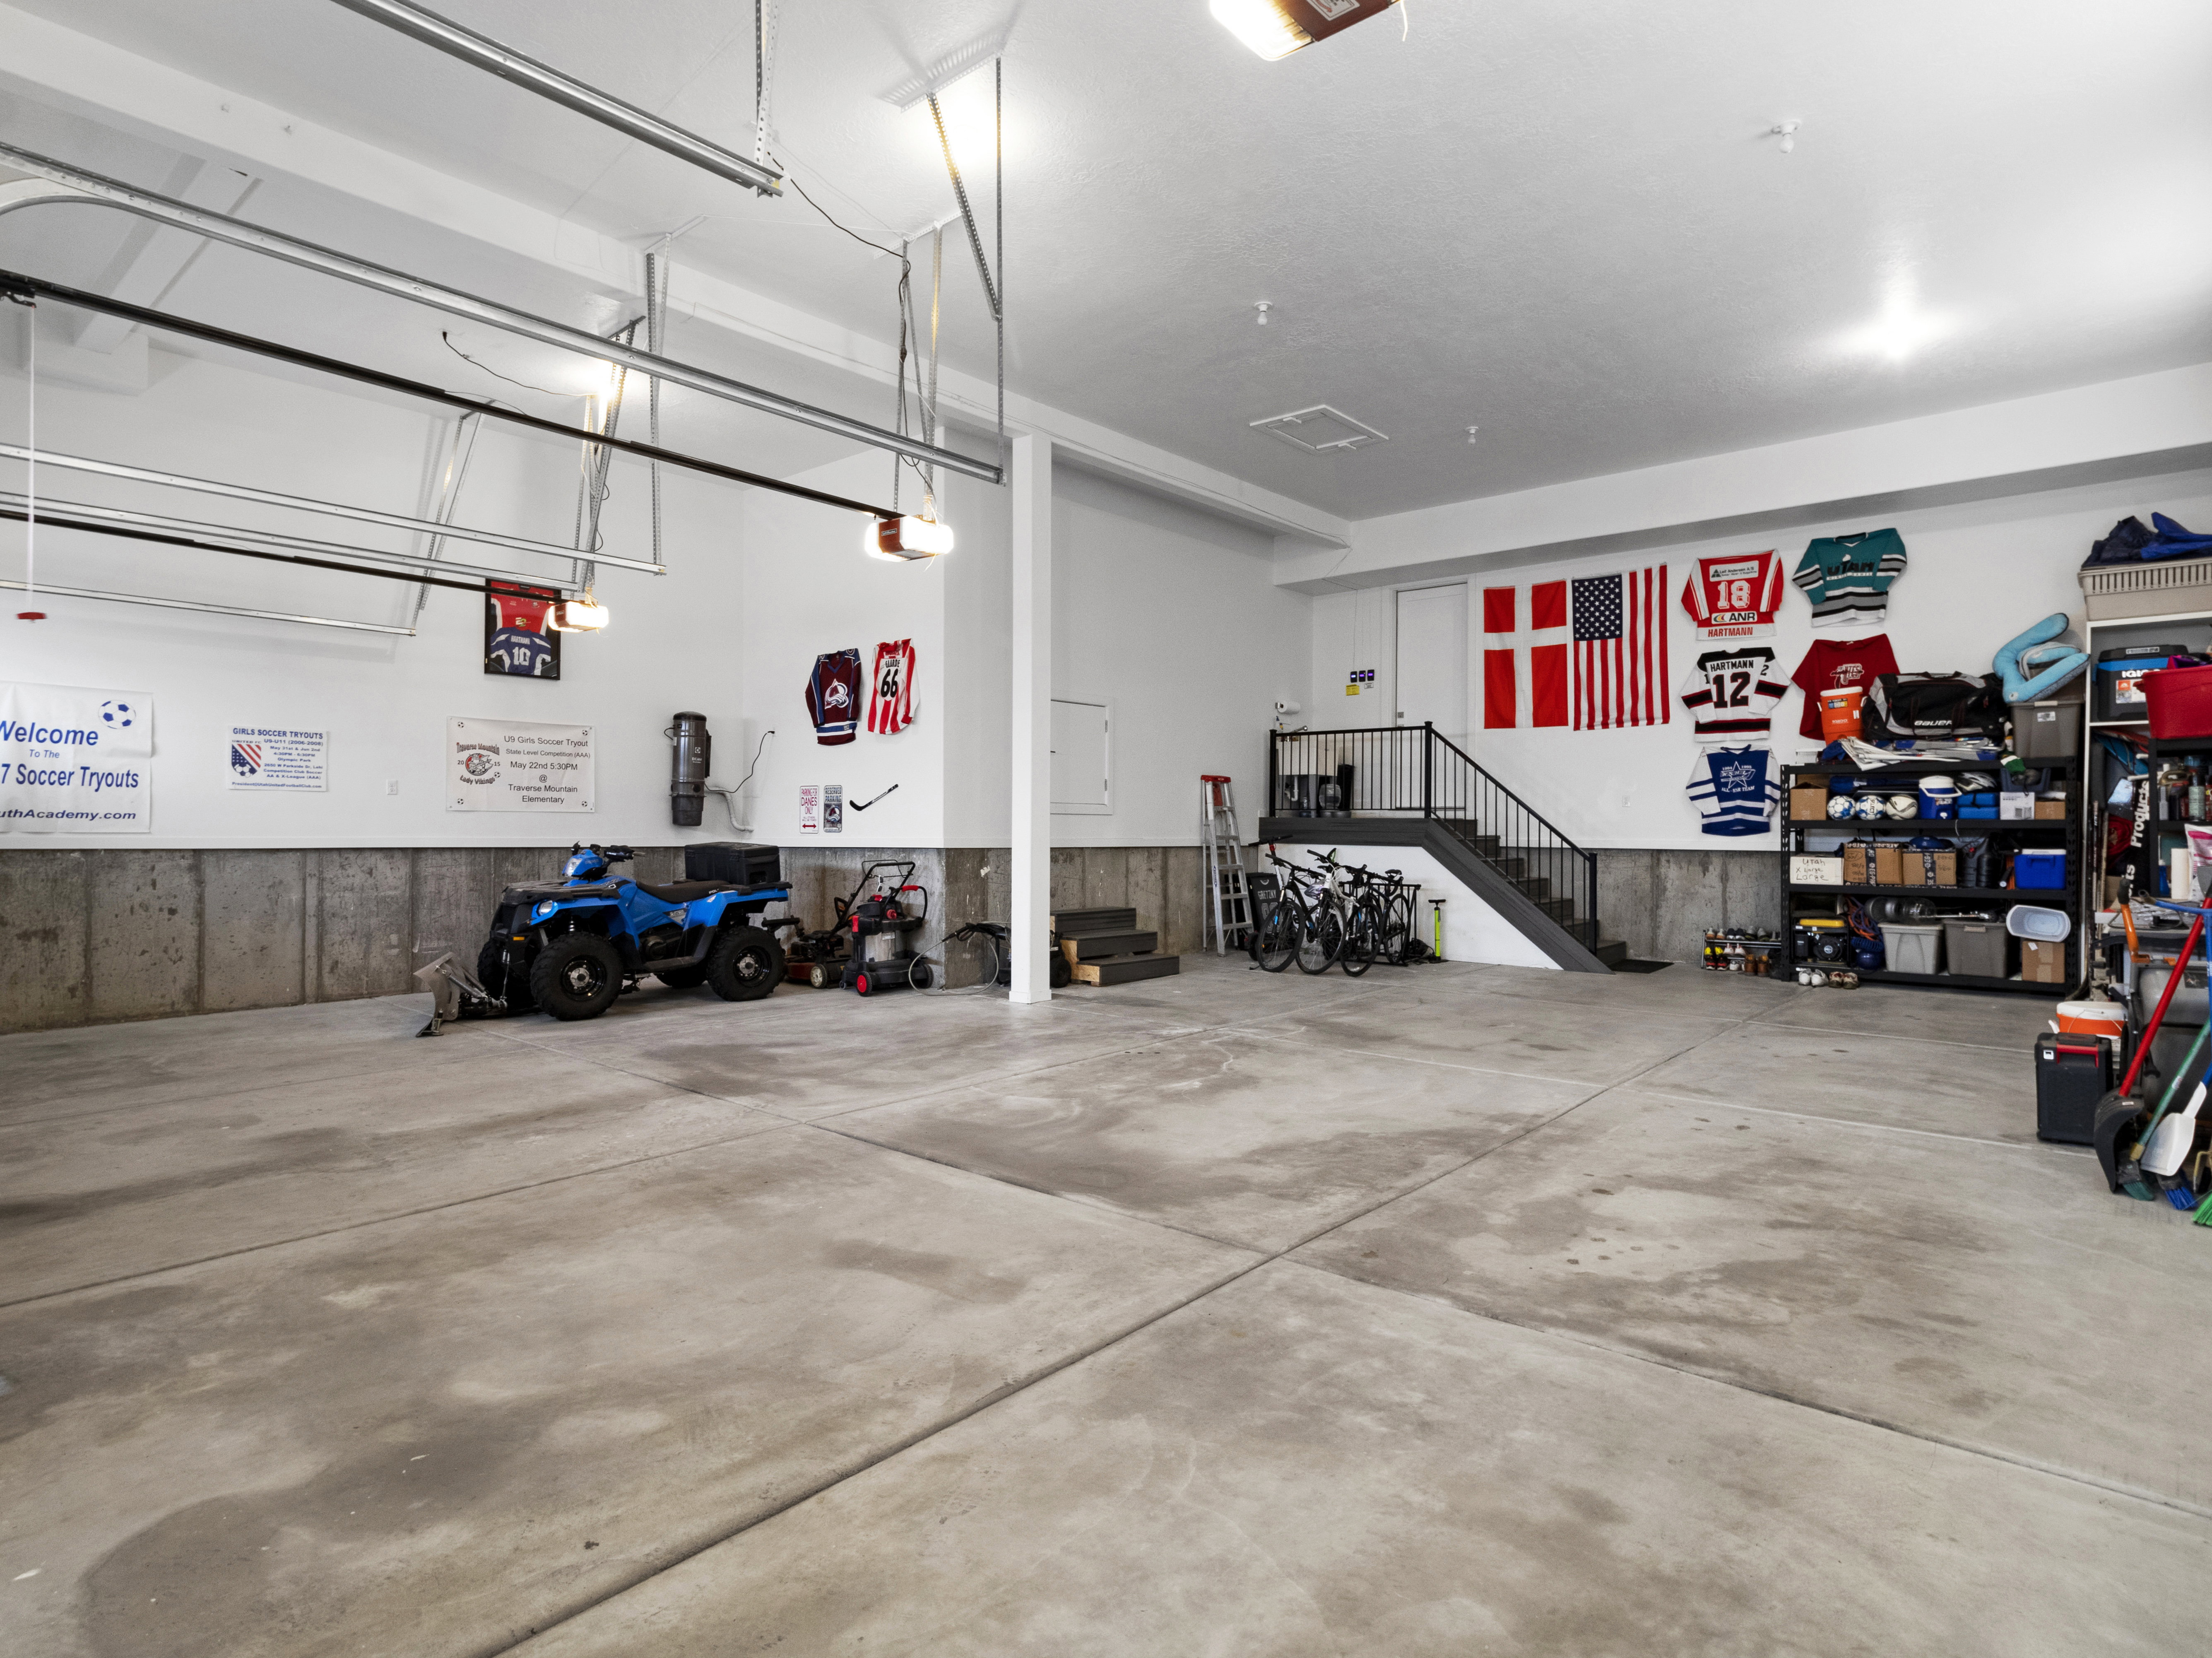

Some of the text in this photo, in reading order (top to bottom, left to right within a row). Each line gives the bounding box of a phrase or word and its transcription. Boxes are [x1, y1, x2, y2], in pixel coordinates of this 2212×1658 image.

[1827, 560, 1875, 576] UTAH
[1718, 580, 1750, 609] 18
[1729, 612, 1755, 622] ANR
[1708, 627, 1753, 637] HARTMANN
[513, 647, 531, 666] 10
[1710, 660, 1754, 672] HARTMANN
[2122, 669, 2160, 678] IGL
[881, 668, 898, 698] 66
[1712, 671, 1751, 709] 12
[289, 731, 323, 740] TRYOUTS
[517, 736, 535, 744] Girls
[538, 737, 563, 745] Soccer
[566, 739, 588, 747] Tryout
[29, 749, 60, 758] To The
[456, 742, 500, 756] Traverse Mountain
[510, 761, 527, 769] May
[1, 763, 139, 792] 7 Soccer Tryouts
[460, 775, 473, 785] Lady
[522, 795, 564, 804] Elementary
[802, 797, 817, 806] DANES
[2130, 781, 2149, 848] Products
[1796, 873, 1829, 882] Large
[1258, 889, 1276, 900] GRETZKY
